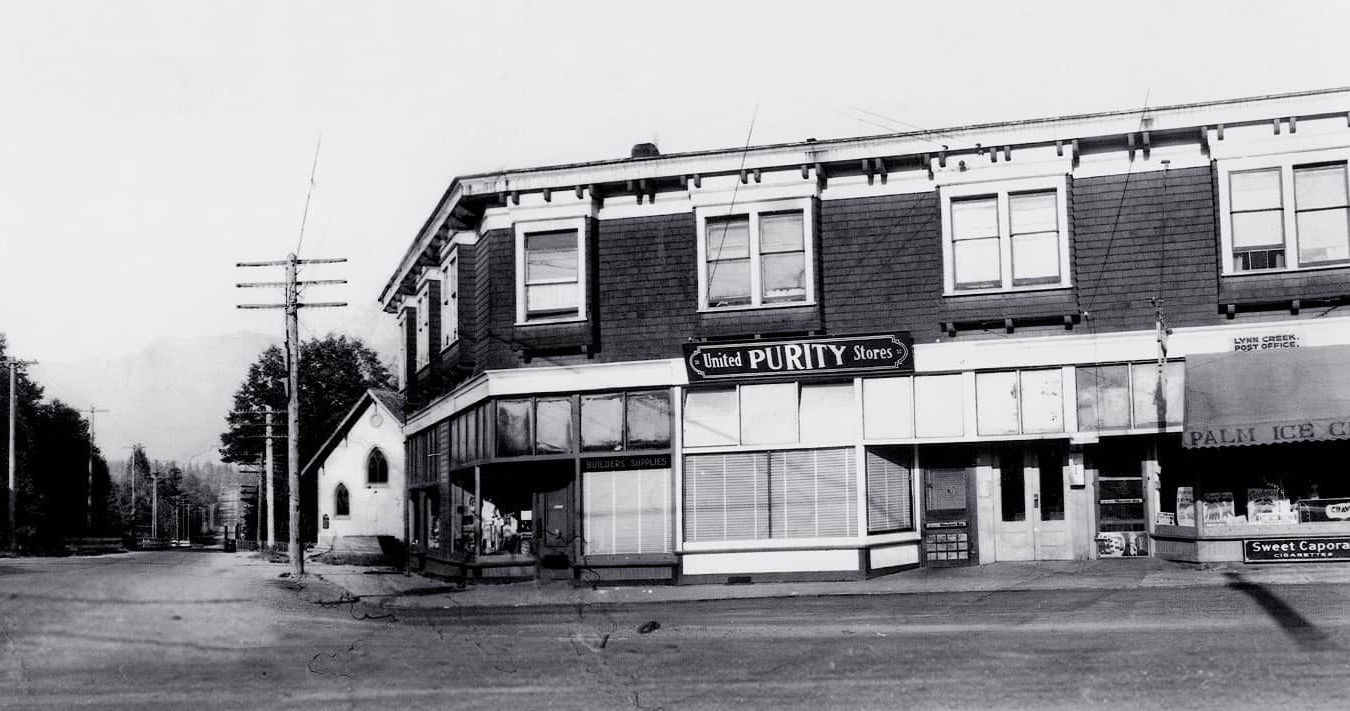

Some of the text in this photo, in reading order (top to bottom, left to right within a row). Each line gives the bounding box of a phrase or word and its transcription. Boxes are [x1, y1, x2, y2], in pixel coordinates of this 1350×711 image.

[1234, 336, 1259, 345] LYNN
[1234, 343, 1259, 352] POST
[702, 343, 893, 371] United PURITY Stores
[1190, 427, 1256, 446] PALM
[1272, 423, 1315, 441] ICE
[586, 457, 667, 469] BUILDERS SUPPLIES
[1252, 541, 1296, 552] Sweet
